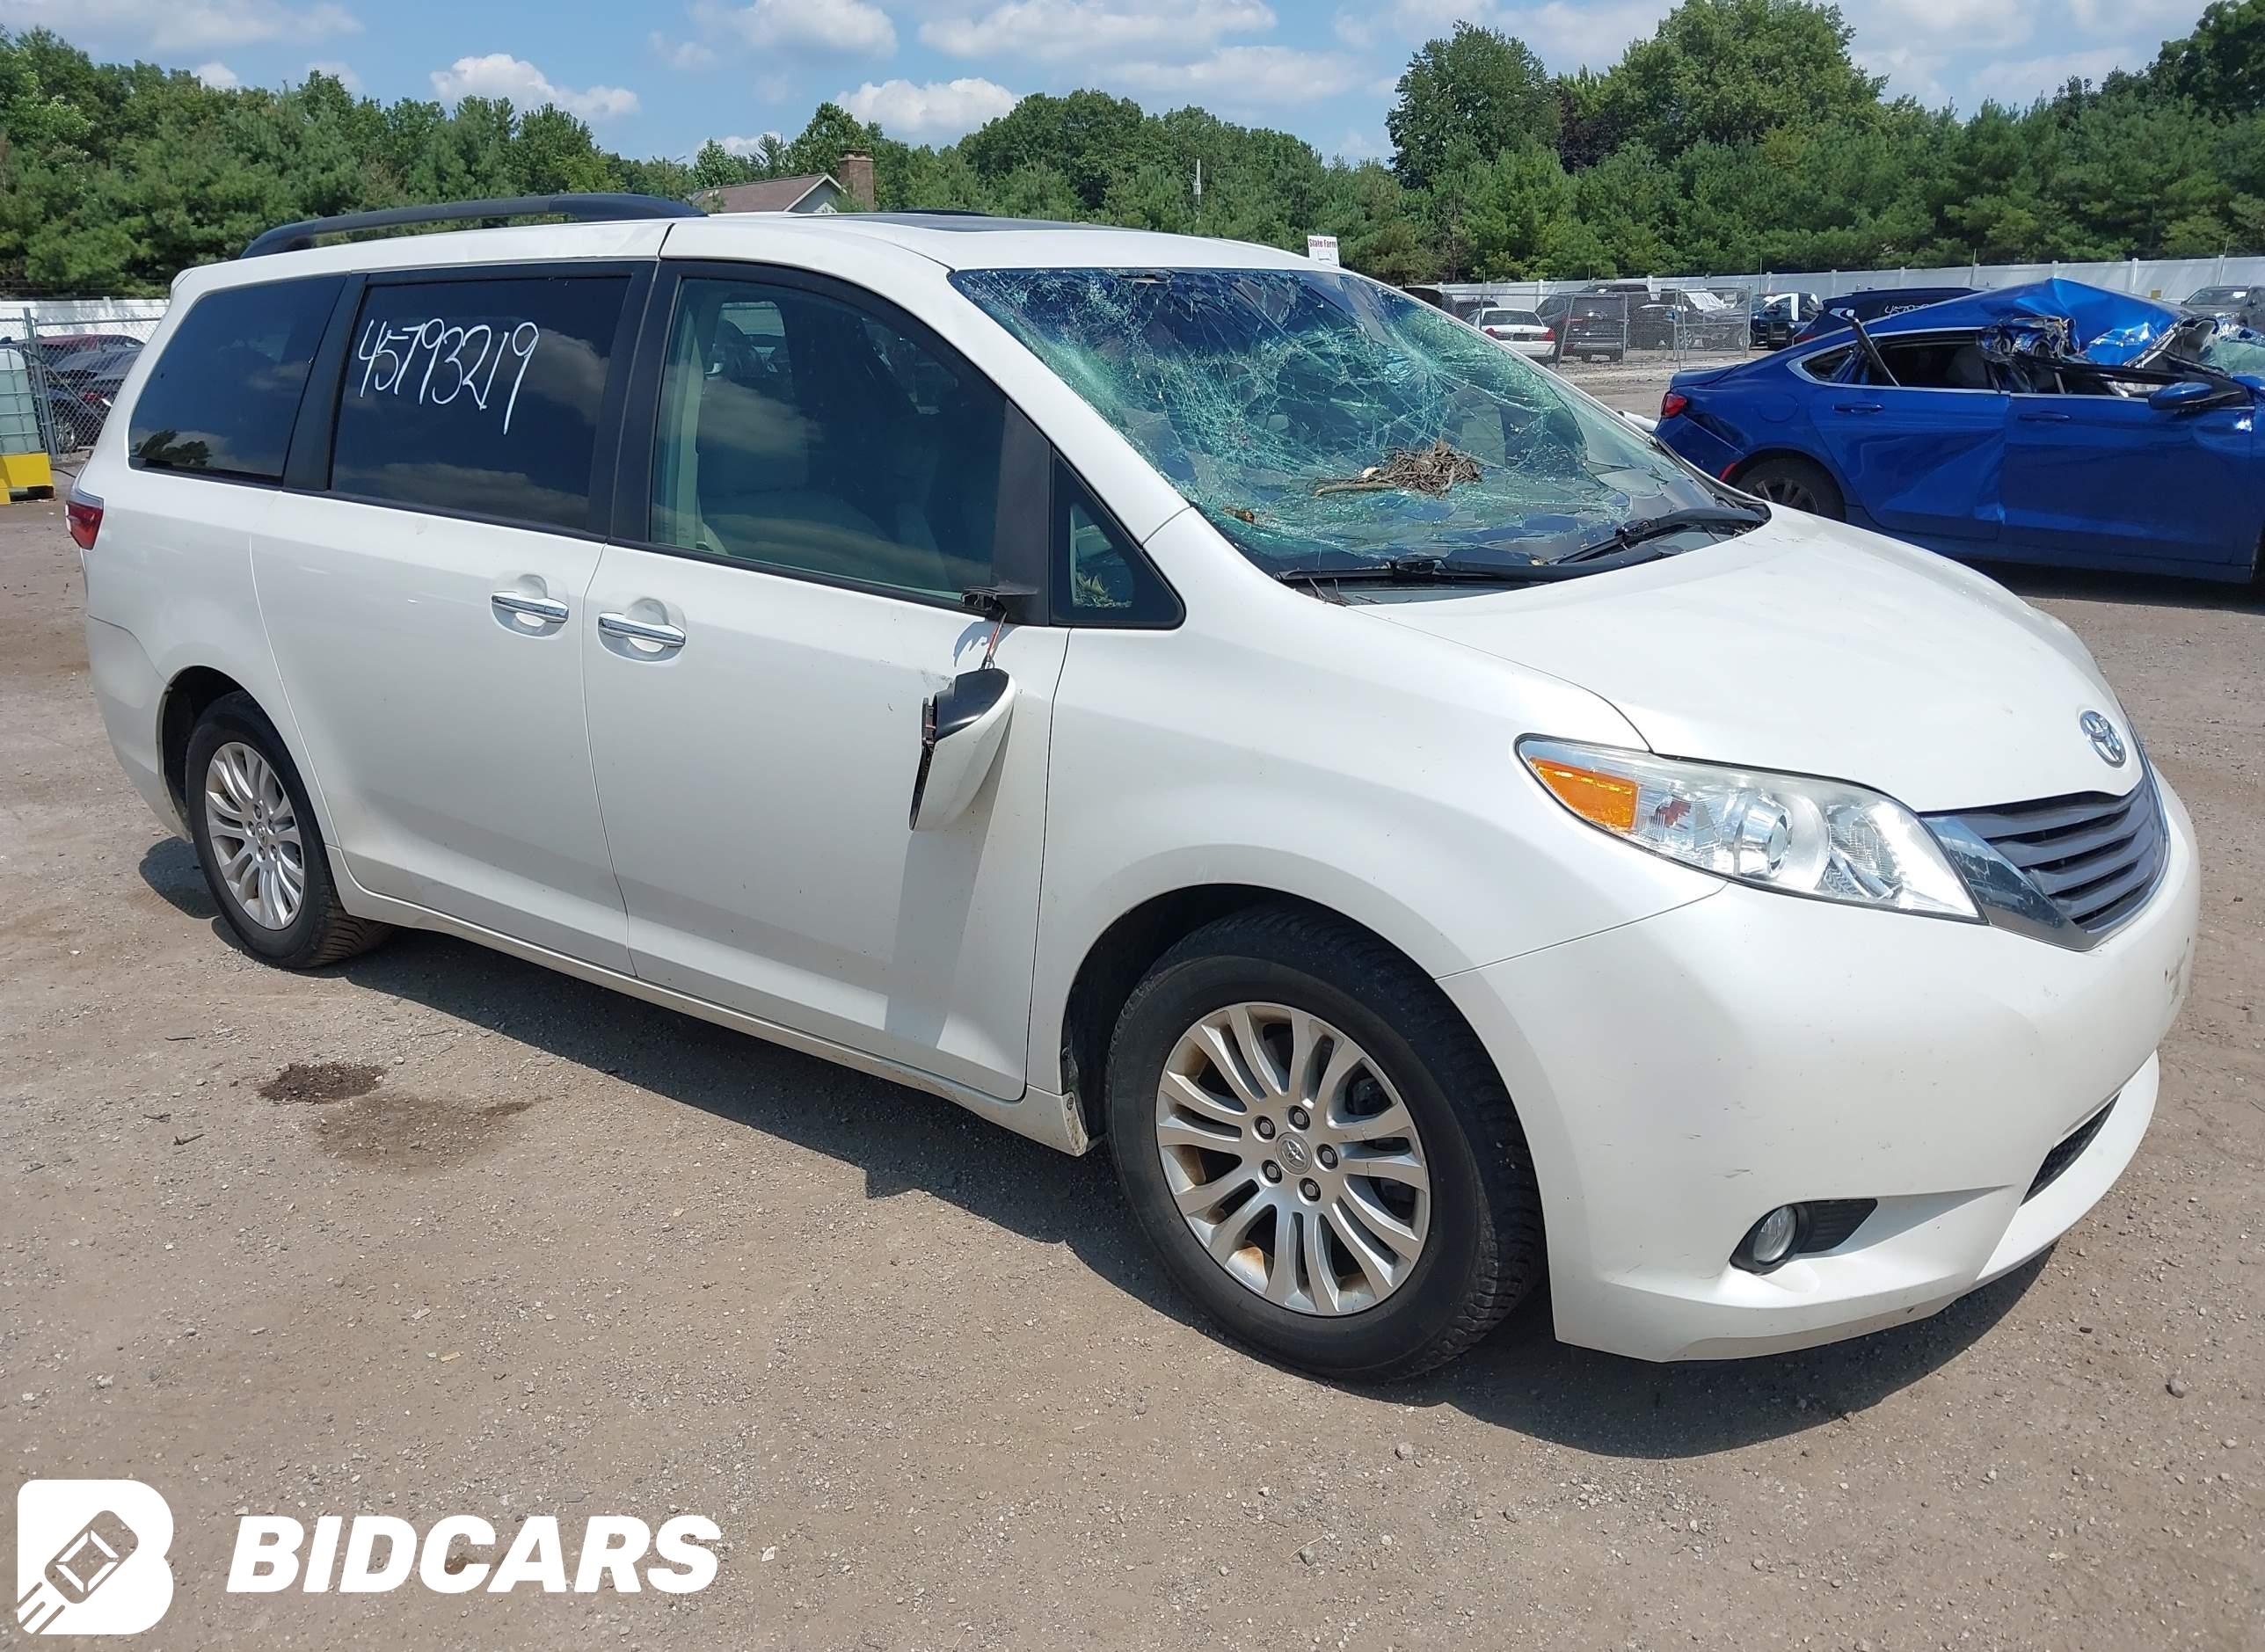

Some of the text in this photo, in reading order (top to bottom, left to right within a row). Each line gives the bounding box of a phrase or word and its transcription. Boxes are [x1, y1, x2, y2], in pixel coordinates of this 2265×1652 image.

[1308, 238, 1337, 249] State Farm
[358, 317, 540, 435] 45793219
